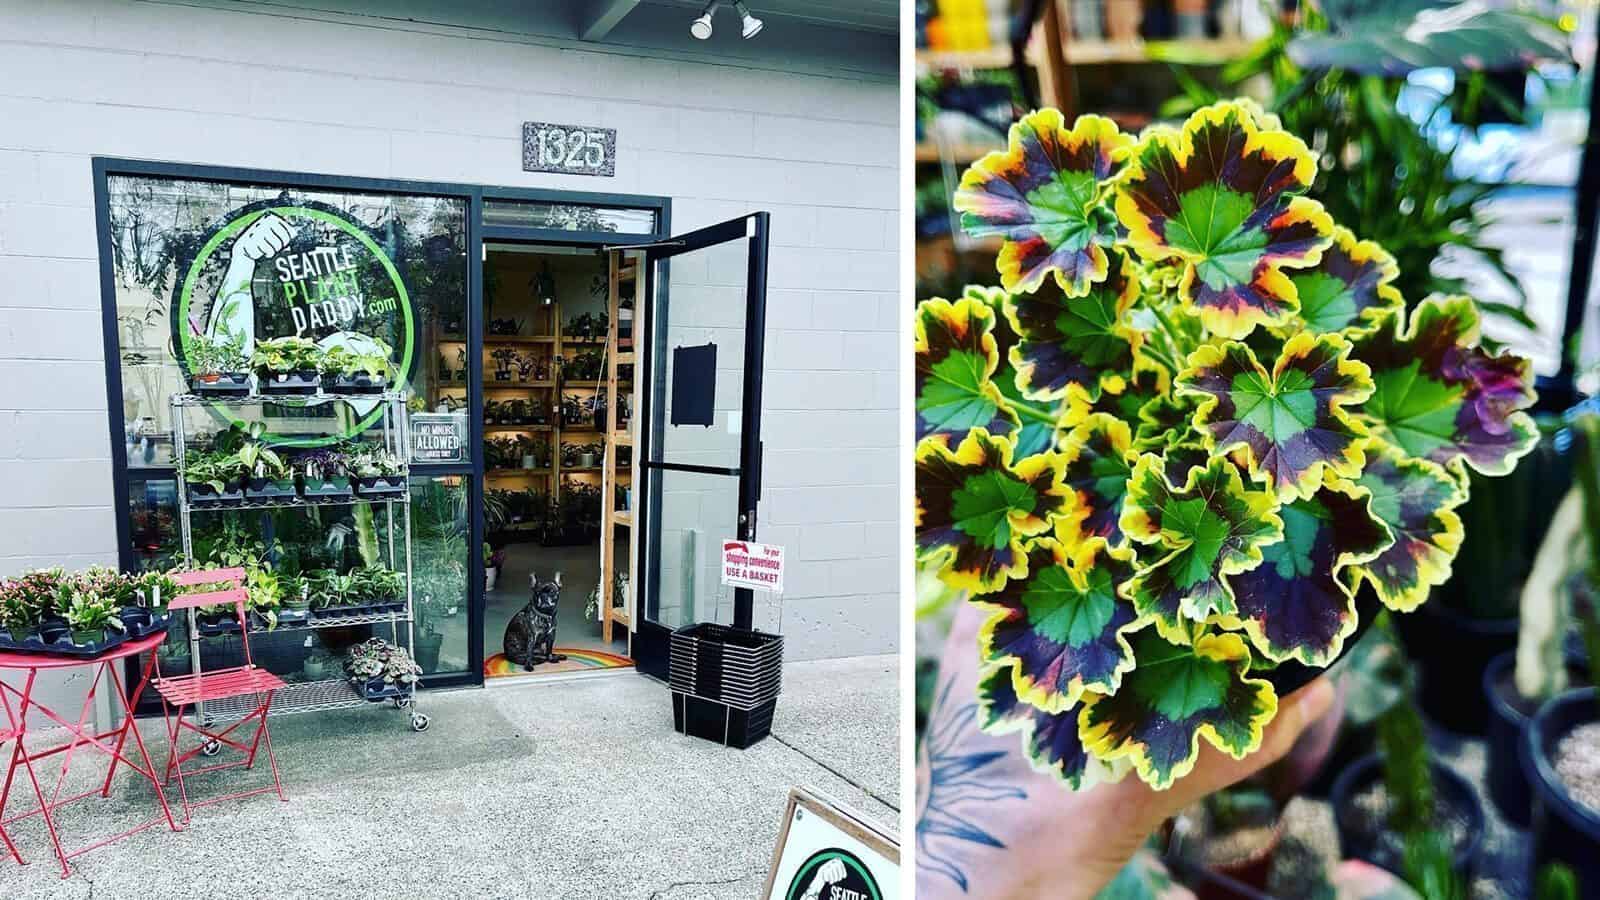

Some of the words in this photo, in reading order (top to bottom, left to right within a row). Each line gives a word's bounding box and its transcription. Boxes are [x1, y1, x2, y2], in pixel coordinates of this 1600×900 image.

[537, 129, 604, 168] 1325
[275, 243, 358, 282] SEATTLE
[283, 269, 360, 307] PLANT
[417, 436, 459, 449] ALLOWED
[726, 567, 740, 578] USE
[742, 569, 747, 579] A
[749, 571, 778, 583] BASKET
